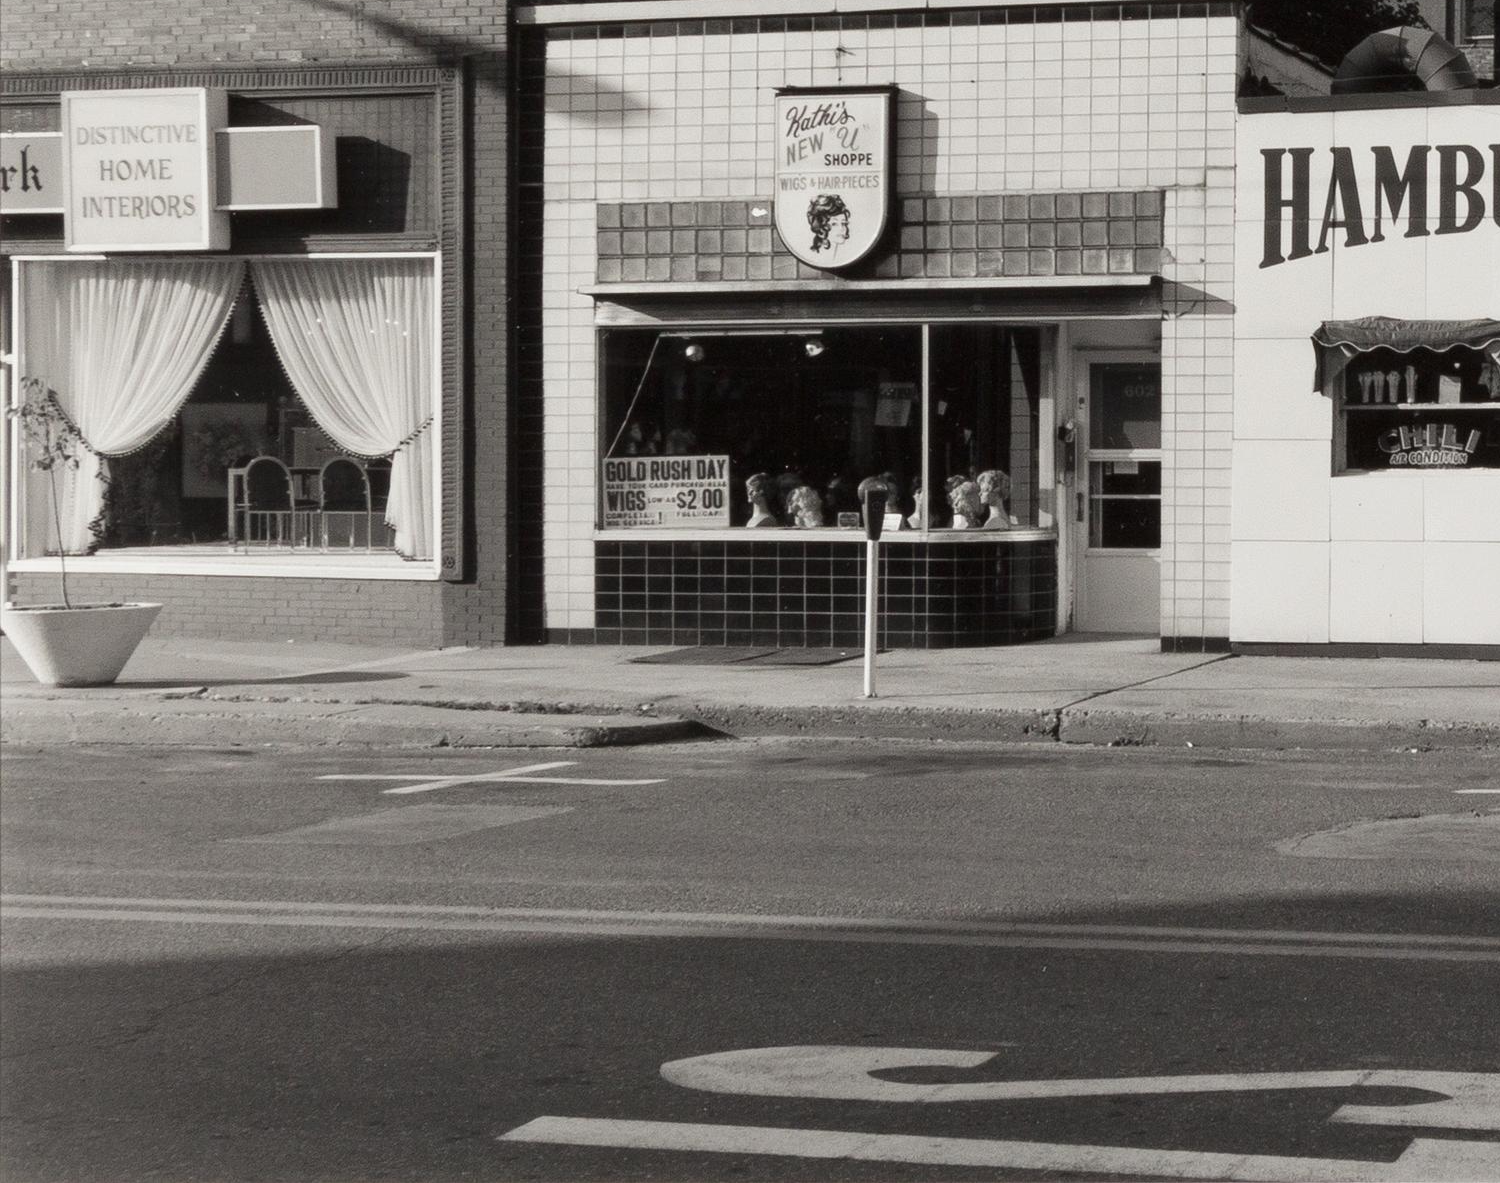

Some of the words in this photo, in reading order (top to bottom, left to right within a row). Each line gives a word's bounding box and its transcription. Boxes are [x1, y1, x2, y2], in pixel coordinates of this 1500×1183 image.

[786, 101, 855, 138] Kathi's
[76, 124, 197, 146] DISTINCTIVE
[787, 131, 824, 166] NEW
[824, 153, 873, 166] SHOPPE
[99, 159, 173, 181] HOME
[780, 177, 807, 191] WIGS
[82, 194, 197, 220] INTERIORS
[1124, 384, 1156, 398] 602
[1378, 422, 1481, 454] CHILI
[1389, 452, 1407, 465] AIR
[1408, 450, 1469, 465] CONDITION
[605, 461, 647, 482] GOLD
[650, 459, 691, 481] RUSH
[696, 459, 726, 480] DAY
[606, 490, 646, 512] WIGS
